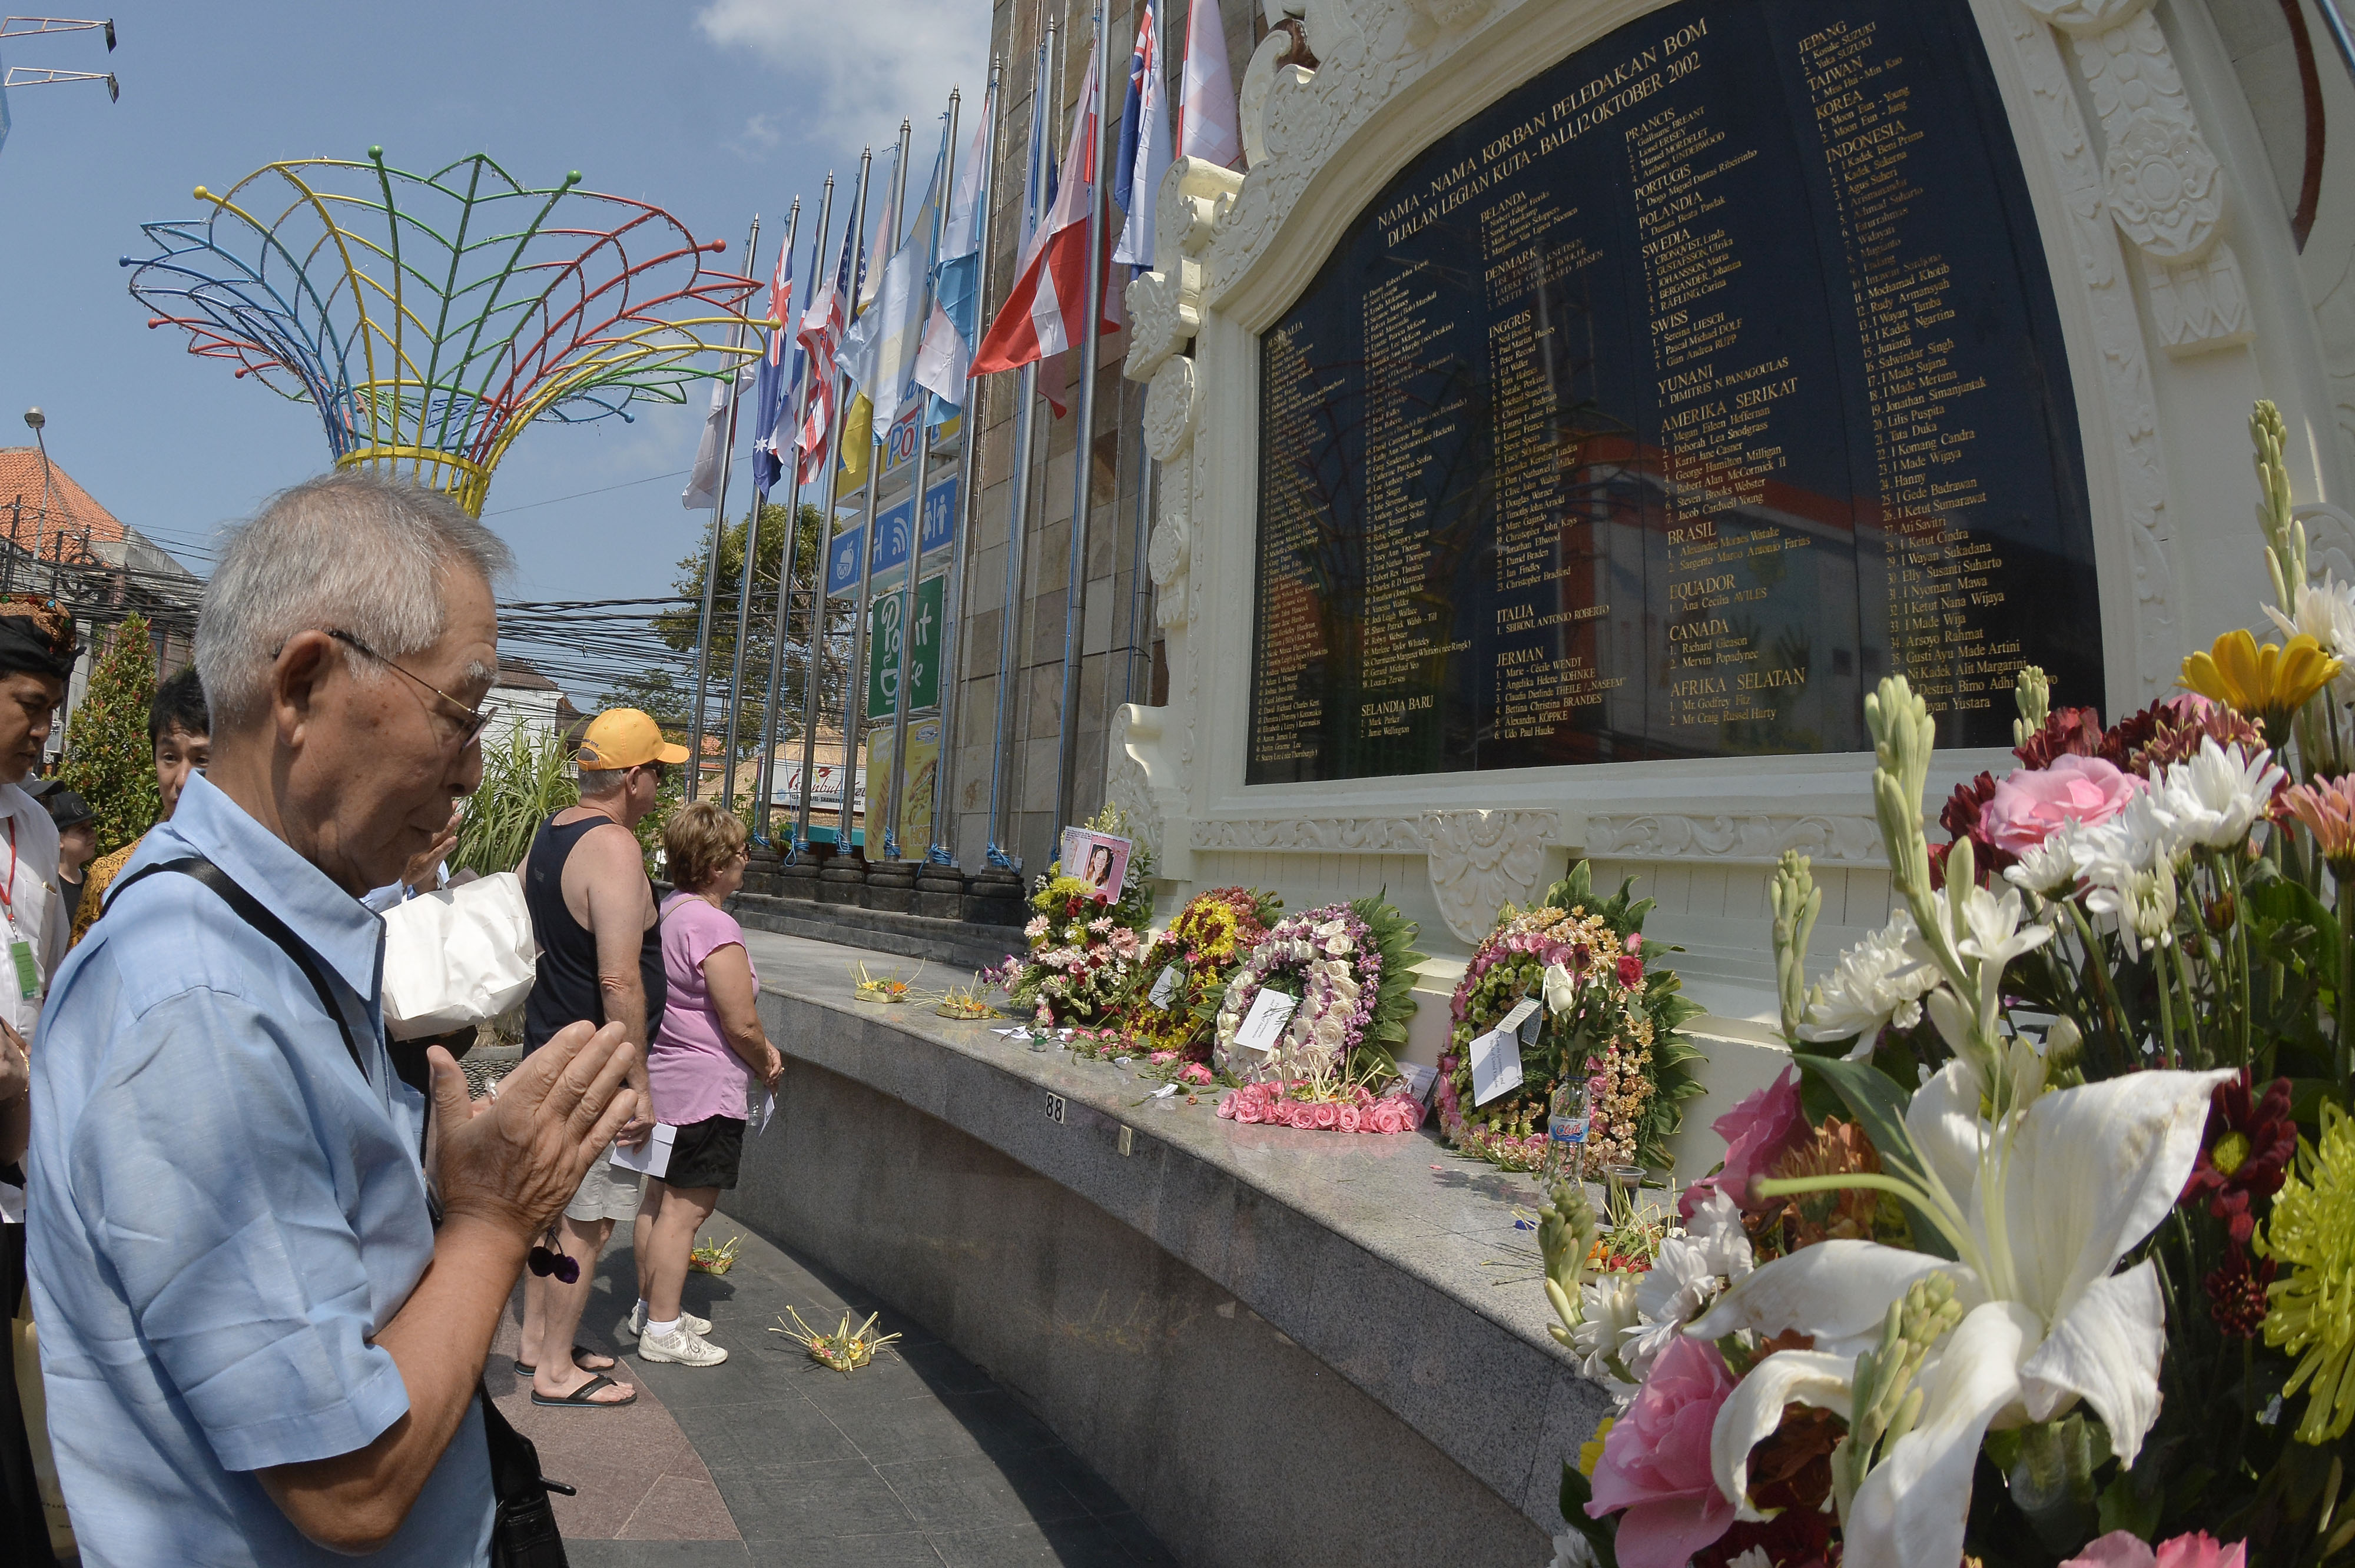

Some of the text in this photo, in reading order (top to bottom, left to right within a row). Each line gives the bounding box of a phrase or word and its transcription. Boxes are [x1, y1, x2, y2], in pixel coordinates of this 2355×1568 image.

[1799, 21, 1847, 54] JEPANG
[1813, 22, 1876, 58] Kosuke SUZUKI
[1816, 36, 1873, 68] Yuka SUZUKI
[1807, 55, 1864, 91] TAIWAN
[1816, 90, 1863, 119] KOREA
[1378, 194, 1419, 230] NAMA
[1431, 157, 1477, 196] NAMA
[1482, 111, 1545, 164] KORBAN
[1552, 46, 1657, 121] PELEDAKAN
[1663, 17, 1707, 57] BOM
[1626, 107, 1675, 142] PRANCIS
[1401, 204, 1437, 240] JALAN
[1442, 172, 1489, 214] LEGIAN
[1493, 150, 1531, 184] KUTA
[1591, 73, 1664, 124] OKTOBER
[1666, 51, 1701, 84] 2002
[1643, 132, 1726, 177] Anthony UNDERWOOD
[1826, 120, 1907, 163] INDONESIA
[1635, 165, 1690, 200] PORTUGIS
[1481, 190, 1526, 223] BELANDA
[1639, 191, 1701, 228] POLANDIA
[1643, 228, 1690, 258] SWEDIA
[1485, 246, 1538, 282] DENMARK
[1869, 263, 1949, 298] Mochamad Khotib
[1870, 278, 1949, 311] Rudy Armansyah
[1489, 310, 1531, 338] INGGRIS
[1651, 310, 1688, 335] SWISS
[1693, 313, 1724, 332] LIESCH
[1715, 335, 1737, 350] RUPP
[1878, 335, 1911, 352] Juniardi
[1879, 338, 1953, 368] Salwindar Singh
[1659, 364, 1713, 394] YUNANI
[1670, 382, 1711, 404] DIMITRIS
[1726, 357, 1789, 385] PANAGOULAS
[1661, 377, 1798, 433] AMERIKA SERIKAT
[1886, 377, 1985, 411] Jonathan Simanjuntak
[1674, 408, 1770, 442] Megan Eileen Heffernan
[1888, 405, 1944, 426] Lilis Puspita
[1674, 422, 1767, 454] Deborah Lea Snodgrass
[1891, 423, 1937, 440] Tata Duka
[1899, 440, 1936, 454] Komang
[1941, 431, 1975, 444] Candra
[1675, 443, 1742, 467] Karri Jane Casner
[1676, 448, 1781, 480] George Hamilton Milligan
[1677, 480, 1701, 494] Robert
[1705, 475, 1723, 486] Alan
[1728, 460, 1774, 481] McCormick
[1895, 475, 1925, 487] Hanny
[1678, 479, 1766, 506] Steven Brooks Webster
[1905, 503, 1931, 516] Ketut
[1933, 493, 1986, 511] Sumarawat
[1679, 495, 1763, 520] Jacob Cardwell Young
[1668, 521, 1716, 545] BRASIL
[1902, 517, 1946, 533] Ati Savitri
[1506, 566, 1570, 589] Christopher Bradford
[1903, 559, 2002, 582] Elly Susanti Suharto
[1670, 574, 1735, 601] EQUADOR
[1911, 584, 1951, 597] Nyoman
[1958, 579, 1987, 589] Mawa
[1497, 604, 1534, 623] ITALIA
[1537, 612, 1571, 626] ANTONIO
[1574, 604, 1609, 619] ROBERTO
[1670, 619, 1729, 640] CANADA
[1906, 629, 1983, 646] Arsoyo Rahmat
[1497, 646, 1543, 666] JERMAN
[1683, 637, 1747, 653] Richard Gleason
[1906, 642, 2019, 663] Gusti Ayu Made Artini
[1683, 651, 1758, 667] Mervin Popadynec
[1908, 659, 2029, 679] Ni Kadek Alit Margarini
[1671, 667, 1806, 697] AFRIKA SELATAN
[1362, 695, 1434, 716] SELANDIA BARU
[1505, 694, 1601, 713] Bettina Christina BRANDES
[1507, 715, 1535, 726] Alexandra
[1046, 1095, 1062, 1121] 88
